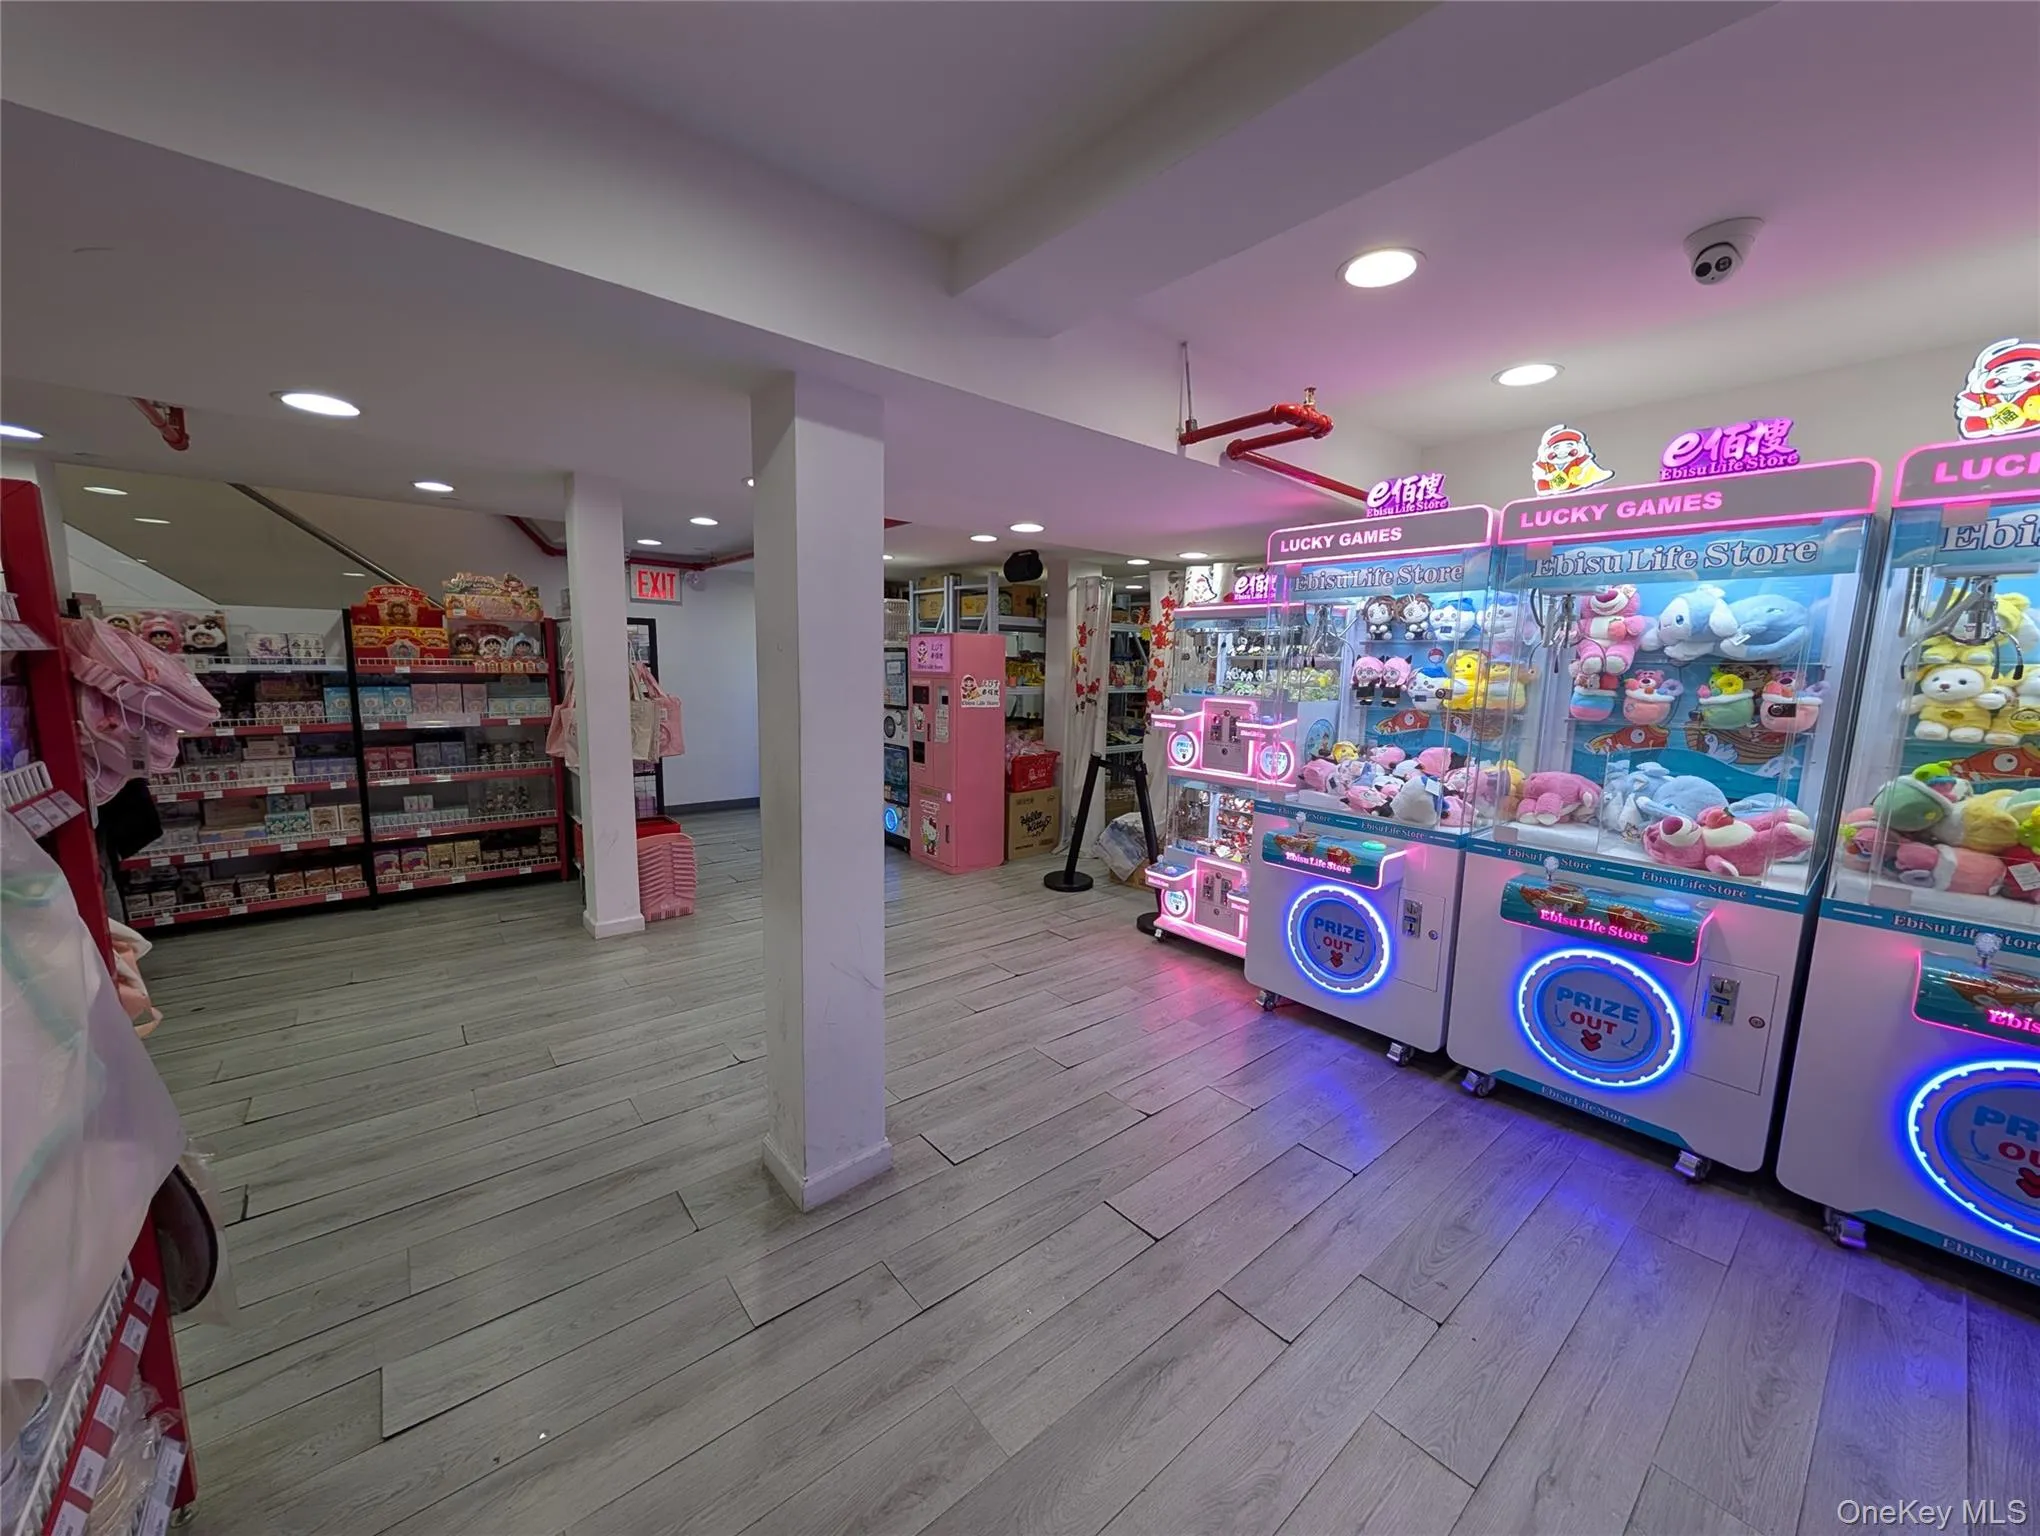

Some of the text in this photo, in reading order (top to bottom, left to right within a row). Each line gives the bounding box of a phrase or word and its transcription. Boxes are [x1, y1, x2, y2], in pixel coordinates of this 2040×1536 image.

[1661, 453, 1799, 480] Ebisu Life Store
[1366, 497, 1447, 518] Ebisu Life Store
[1520, 490, 1723, 528] LUCKY GAMES
[1280, 526, 1402, 553] LUCKY GAMES
[1941, 514, 2040, 552] Ebi
[1532, 538, 1819, 578] Ebisu Life Store
[637, 570, 675, 599] EXIT
[1294, 563, 1465, 592] Ebisu Life Store
[1361, 820, 1425, 840] Ebisu Life Store
[1285, 852, 1352, 874] Ebisu Life Store
[1507, 847, 1537, 861] Ebisu
[1560, 857, 1592, 871] Store
[1642, 870, 1748, 899] Ebisu Life Store
[1313, 916, 1366, 944] PRIZE
[1540, 909, 1649, 944] Ebisu Life Store
[1893, 914, 1946, 935] Ebisu
[1323, 936, 1353, 953] OUT
[1556, 986, 1640, 1025] PRIZE
[1570, 1011, 1617, 1035] OUT
[1943, 1236, 1997, 1267] Ebisu
